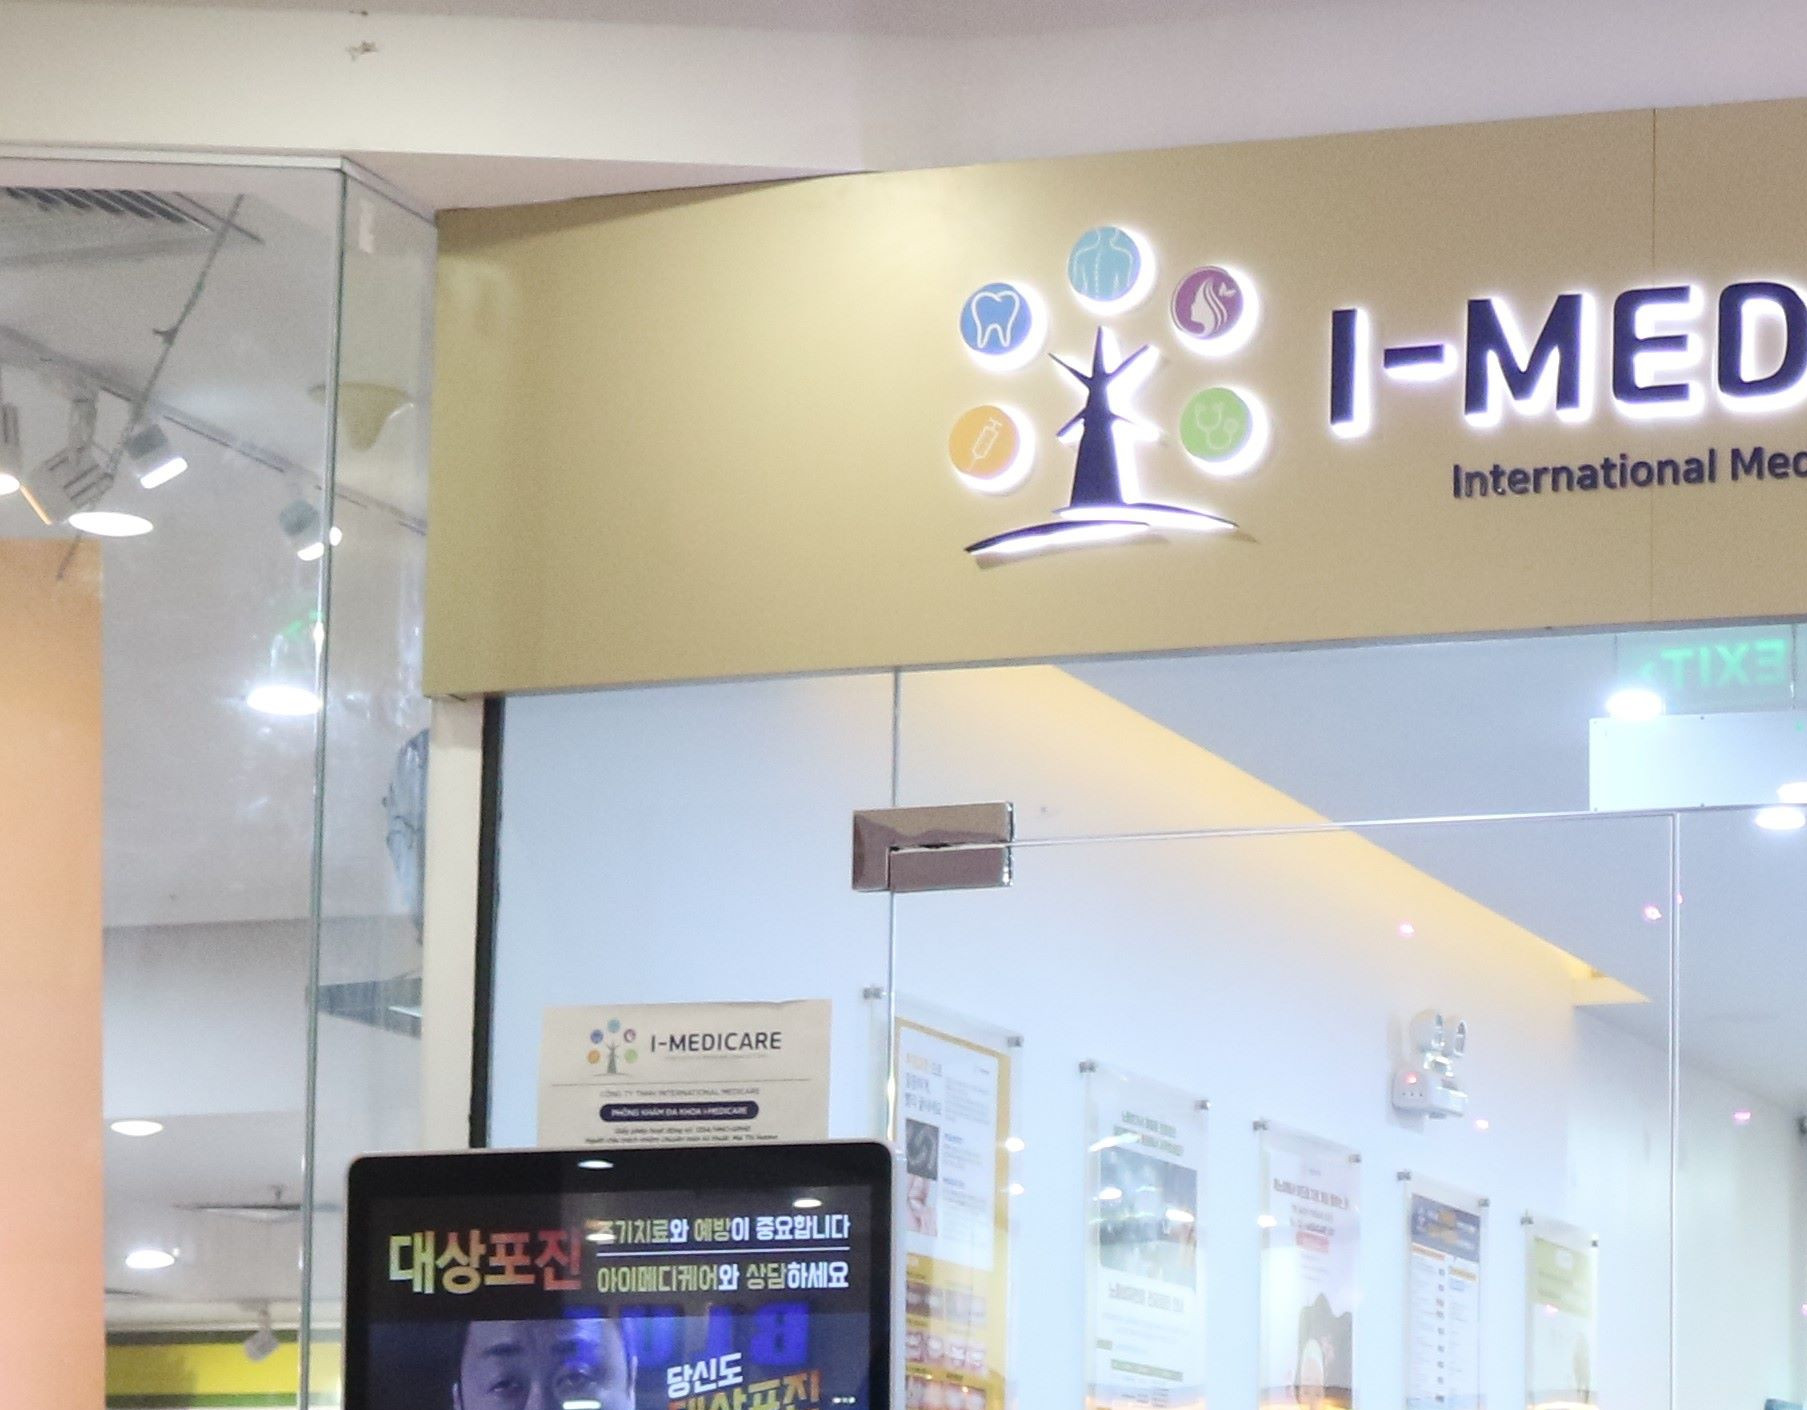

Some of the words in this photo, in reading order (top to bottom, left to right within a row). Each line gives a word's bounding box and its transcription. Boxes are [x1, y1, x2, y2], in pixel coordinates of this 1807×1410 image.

[1451, 445, 1718, 500] International
[651, 1031, 782, 1053] I-MEDICARE
[694, 1216, 750, 1241] 예방이
[756, 1213, 850, 1240] 중요합니다
[388, 1225, 581, 1294] 대상포진
[597, 1264, 740, 1294] 아이메디케어와
[746, 1261, 849, 1289] 상담하세요
[666, 1352, 744, 1400] 당신도
